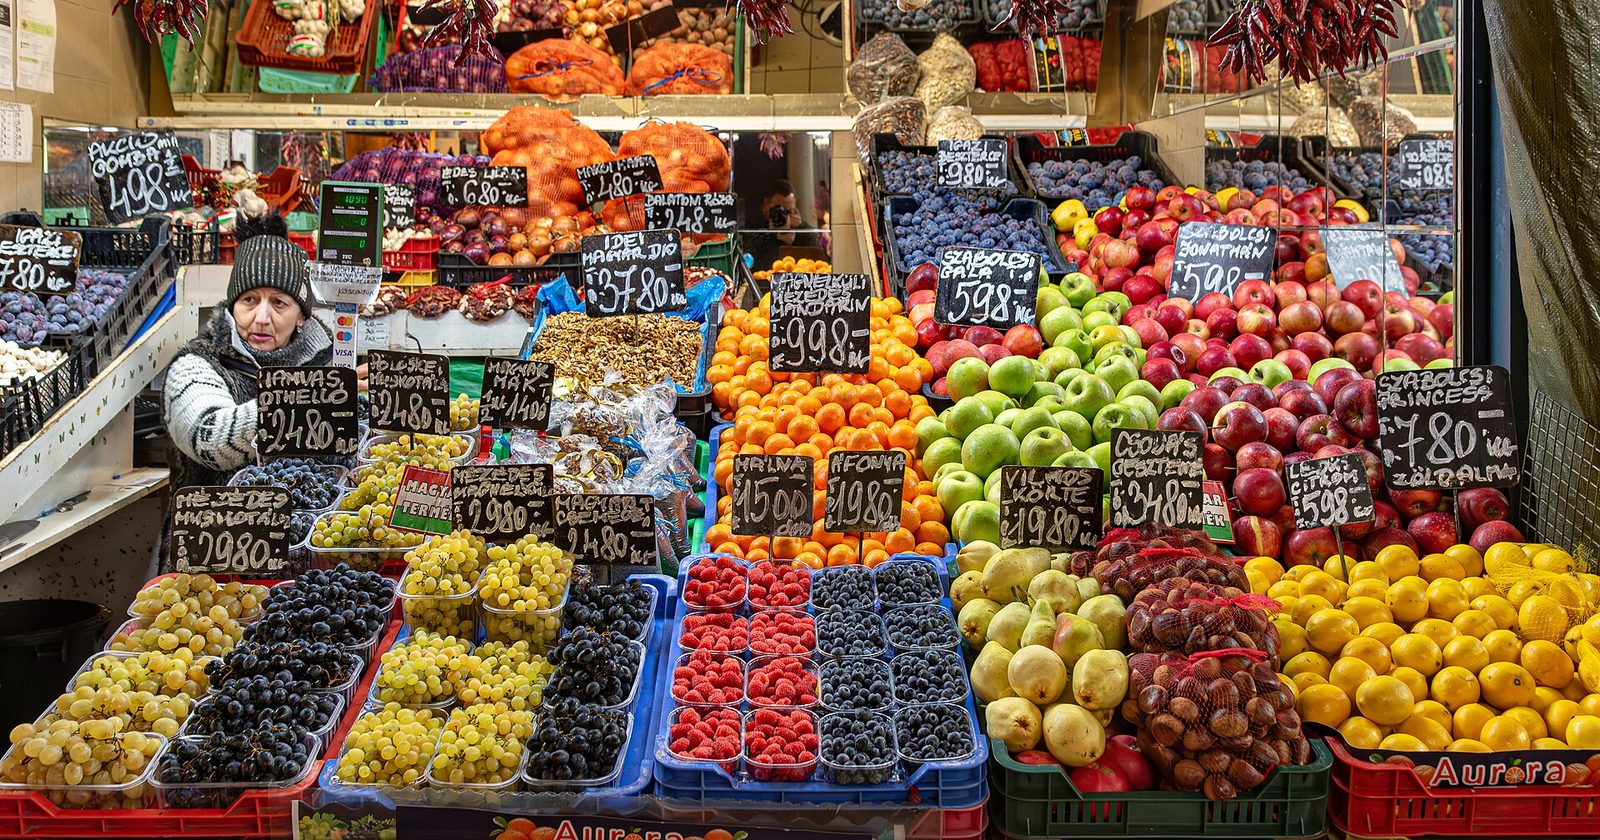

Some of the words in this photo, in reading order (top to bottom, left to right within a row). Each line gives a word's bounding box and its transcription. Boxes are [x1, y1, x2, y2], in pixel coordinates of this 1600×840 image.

[941, 265, 992, 280] GALA
[1005, 468, 1093, 490] VILMOS
[402, 501, 452, 521] TERMÉ
[1429, 756, 1566, 787] Aurora
